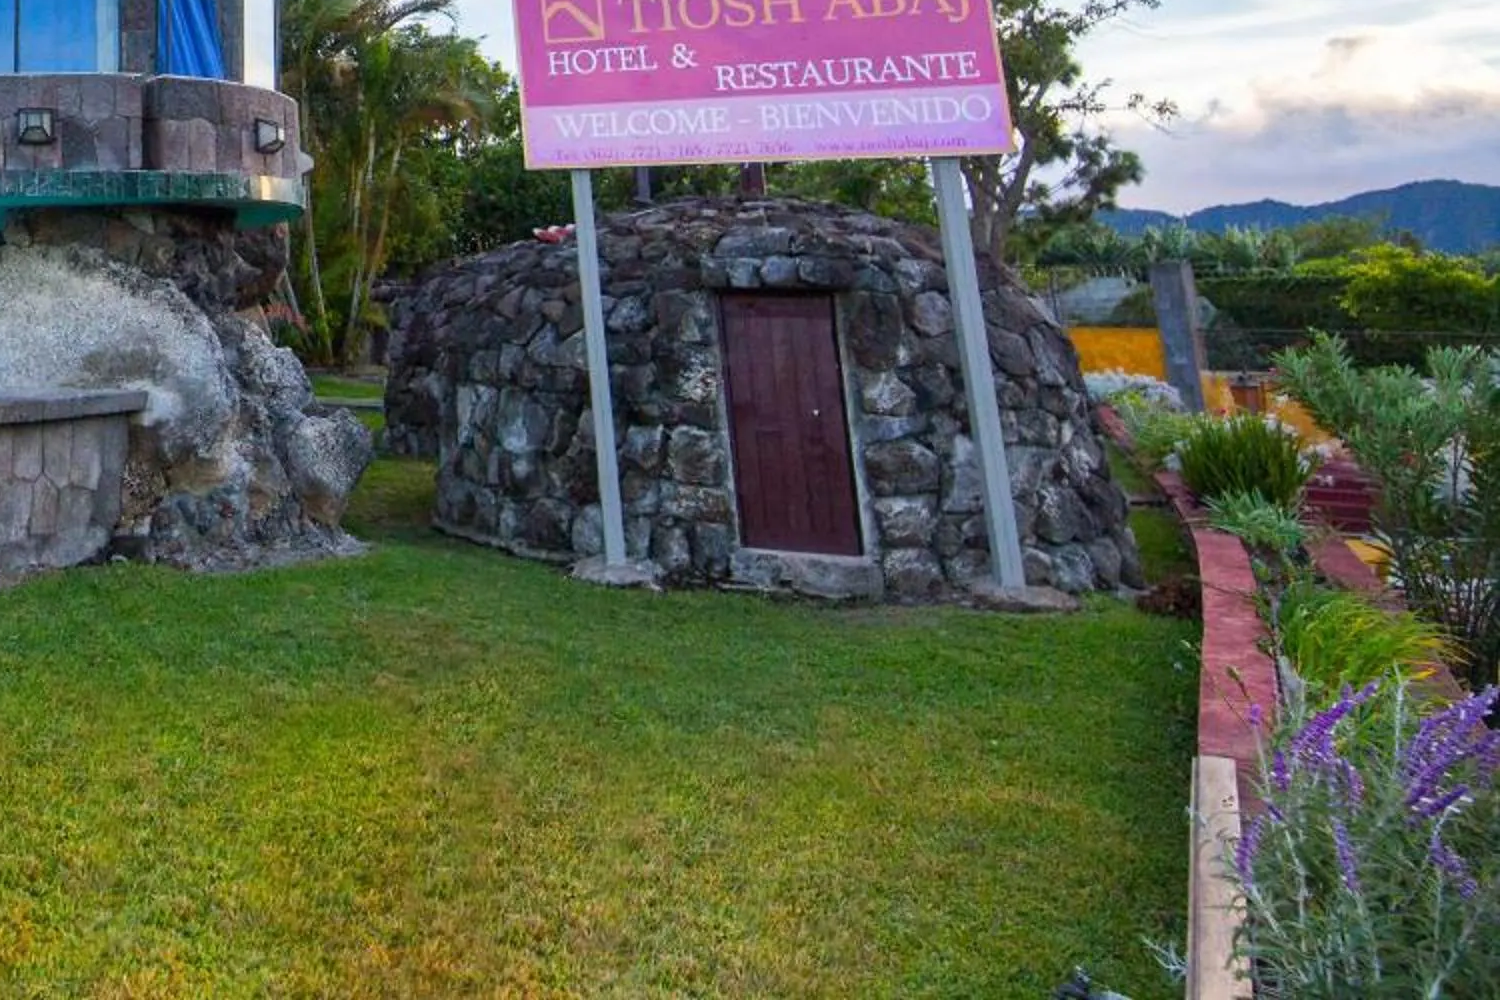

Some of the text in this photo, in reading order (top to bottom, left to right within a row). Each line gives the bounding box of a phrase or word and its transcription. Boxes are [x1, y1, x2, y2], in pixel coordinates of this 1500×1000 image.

[548, 43, 698, 77] HOTEL &
[714, 51, 981, 91] RESTAURANTE
[555, 106, 731, 140] WELCOME
[758, 93, 992, 132] BIENVENIDO
